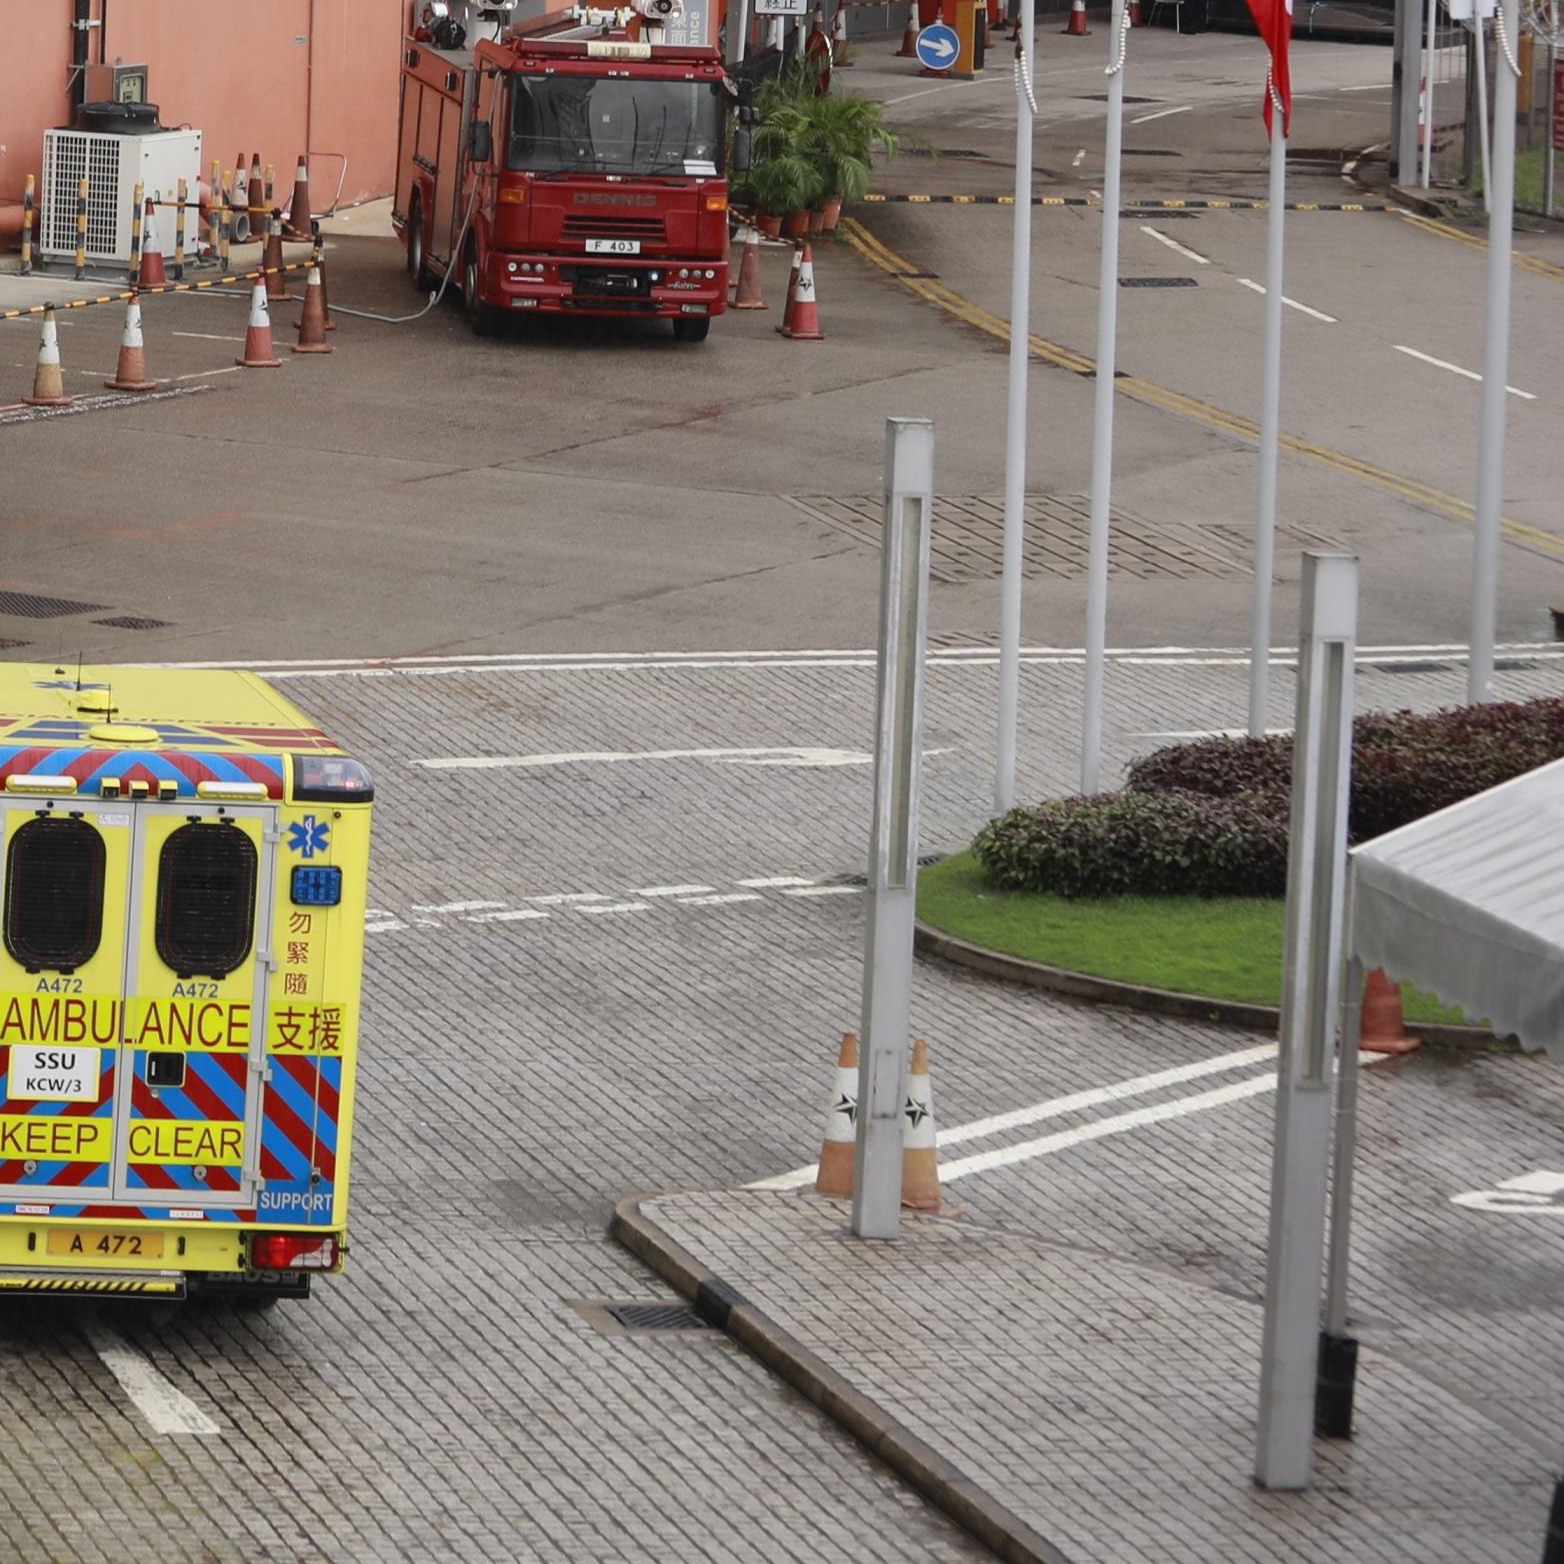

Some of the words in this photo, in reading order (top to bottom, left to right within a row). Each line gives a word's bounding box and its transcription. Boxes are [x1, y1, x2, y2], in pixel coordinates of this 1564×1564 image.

[573, 192, 657, 207] DENNIS
[595, 240, 602, 251] F
[610, 241, 634, 252] 403
[284, 911, 312, 995] 勿緊隨
[36, 977, 83, 993] A472
[172, 982, 219, 998] A472
[0, 997, 251, 1047] AMBULANCE
[272, 1006, 342, 1051] 支援
[34, 1052, 76, 1070] SSU
[26, 1077, 82, 1093] KCW/3
[0, 1123, 100, 1155] KEEP
[128, 1126, 242, 1159] CLEAR
[260, 1192, 333, 1210] SUPPORT
[70, 1233, 83, 1253] A
[96, 1235, 142, 1255] 472
